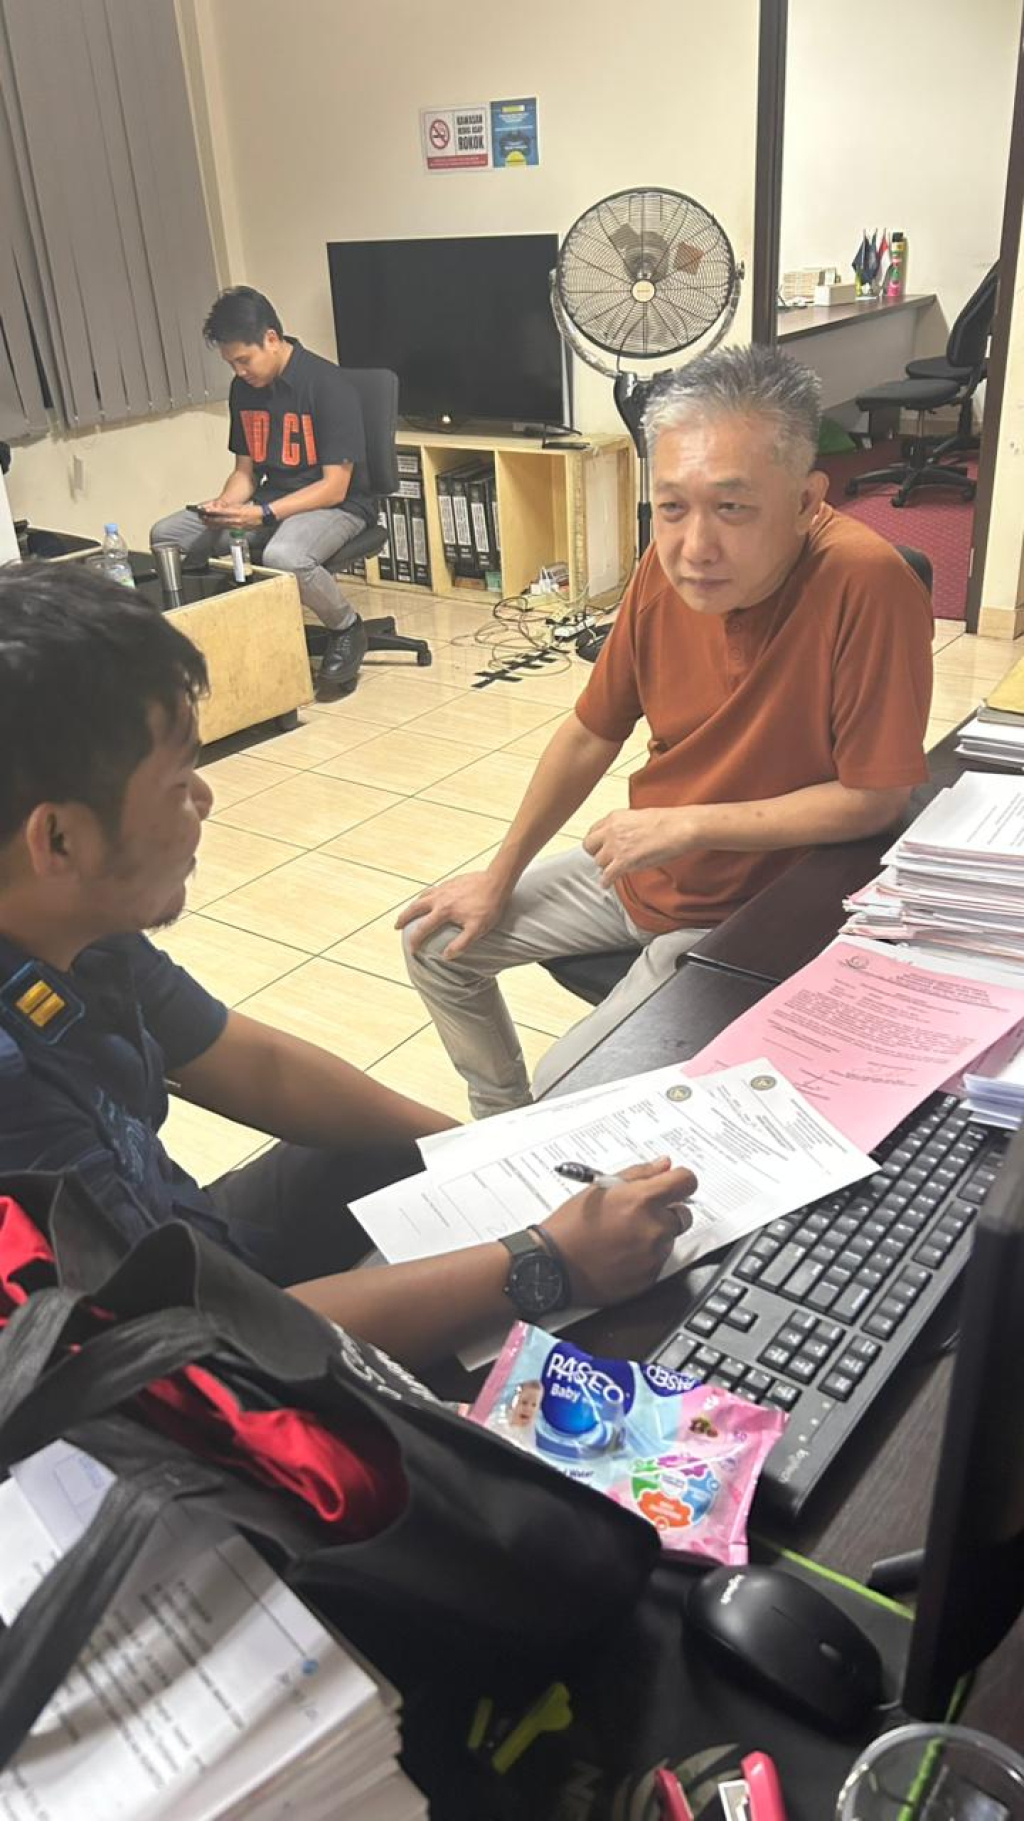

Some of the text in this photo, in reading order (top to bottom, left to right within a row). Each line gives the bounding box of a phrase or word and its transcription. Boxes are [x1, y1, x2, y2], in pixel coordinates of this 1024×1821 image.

[458, 135, 484, 150] ROKOK
[546, 1353, 624, 1403] PASEO
[550, 1383, 581, 1404] Baby
